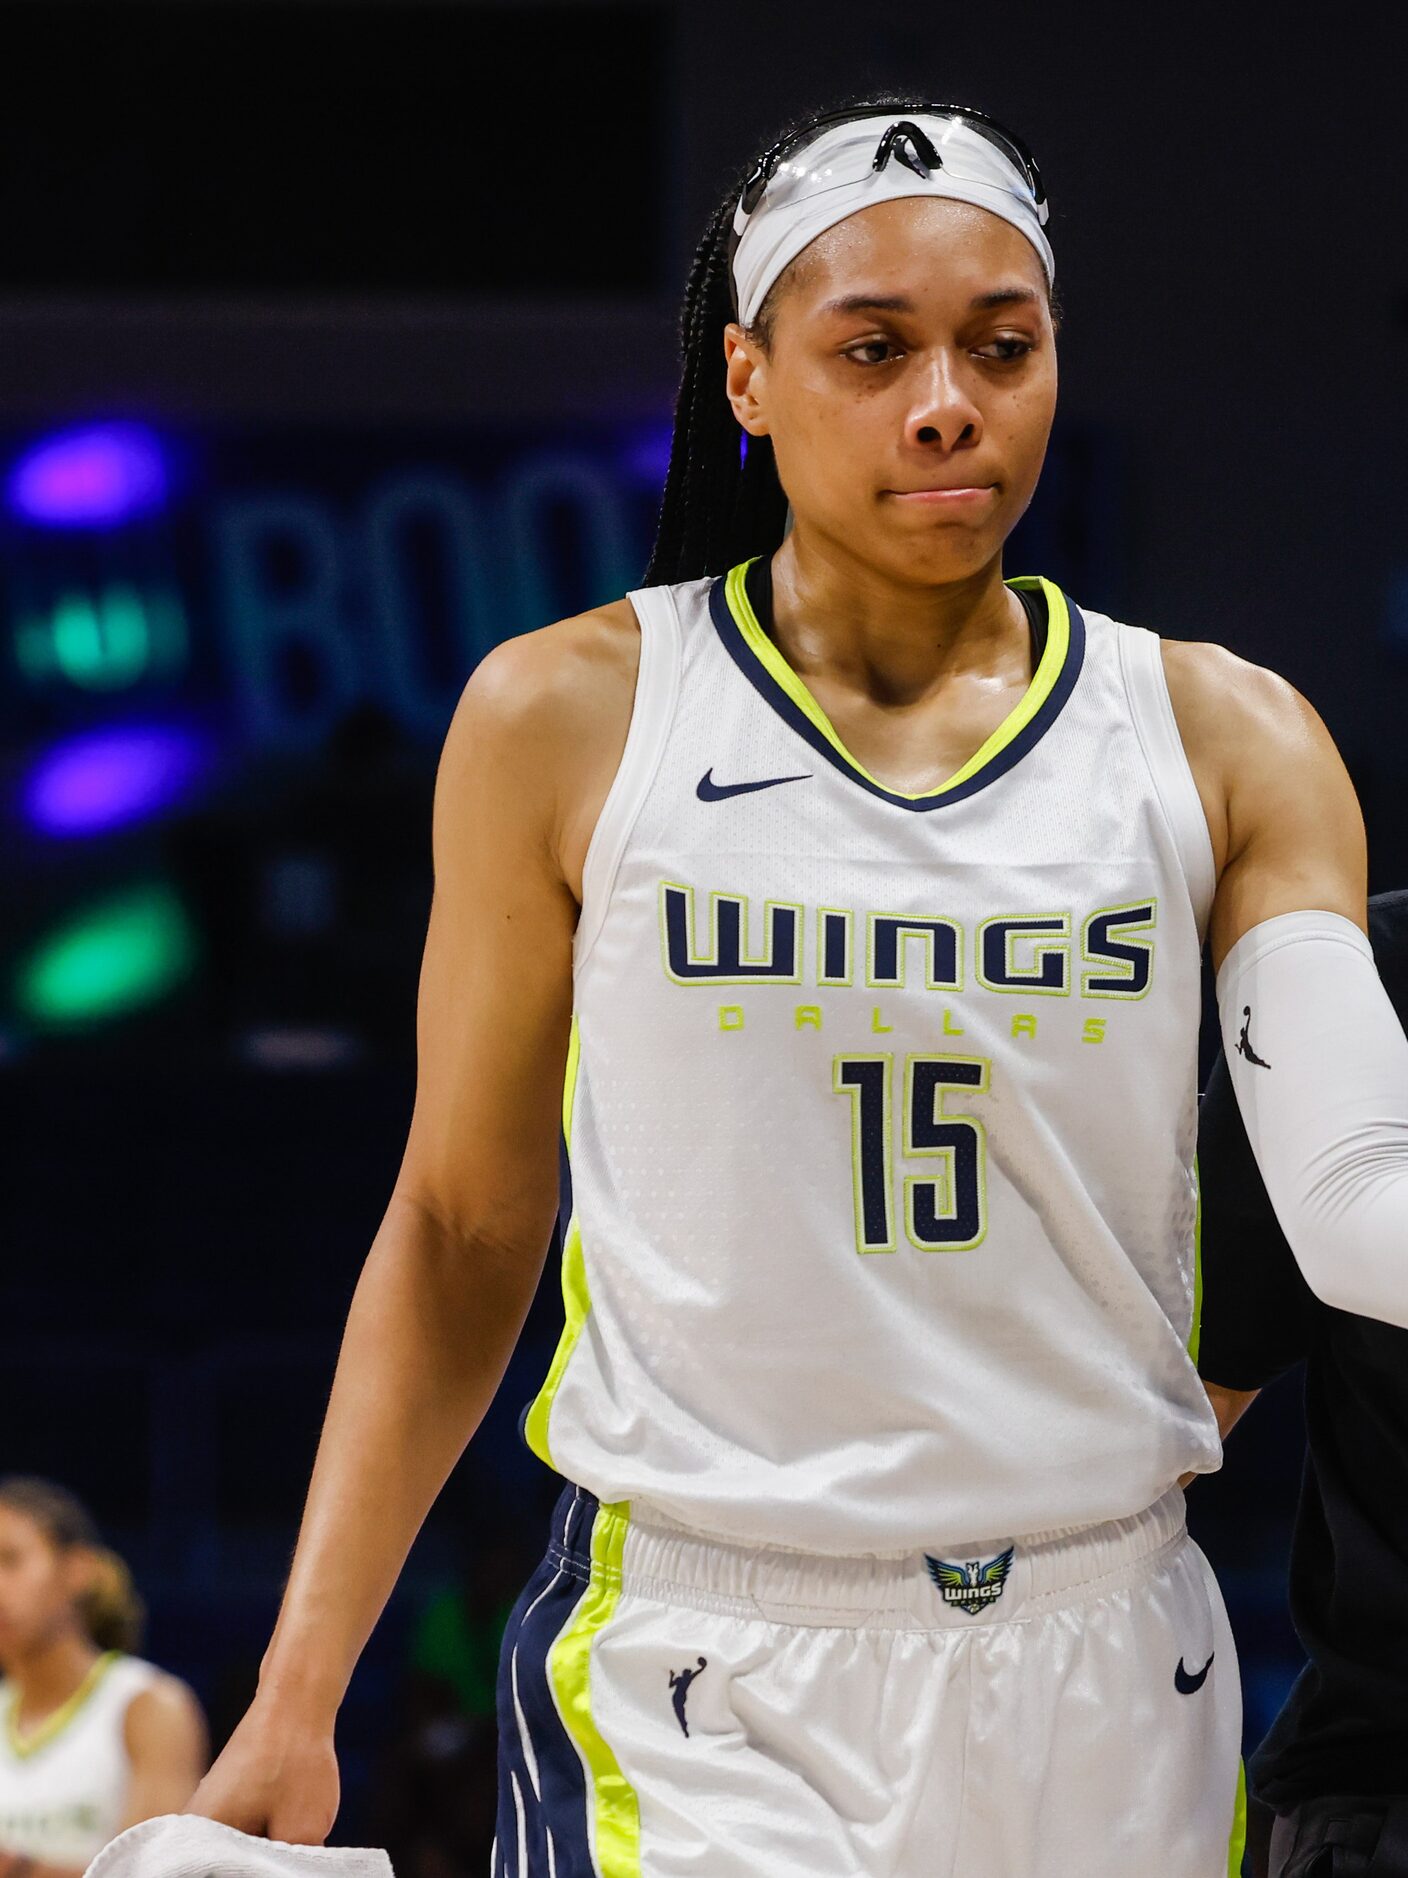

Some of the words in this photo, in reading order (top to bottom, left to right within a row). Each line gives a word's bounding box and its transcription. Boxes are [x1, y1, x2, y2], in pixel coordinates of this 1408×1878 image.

[660, 881, 1157, 1001] WINGS
[718, 1004, 1107, 1044] DALLAS
[832, 1053, 991, 1254] 15
[944, 1581, 1002, 1601] WINGS
